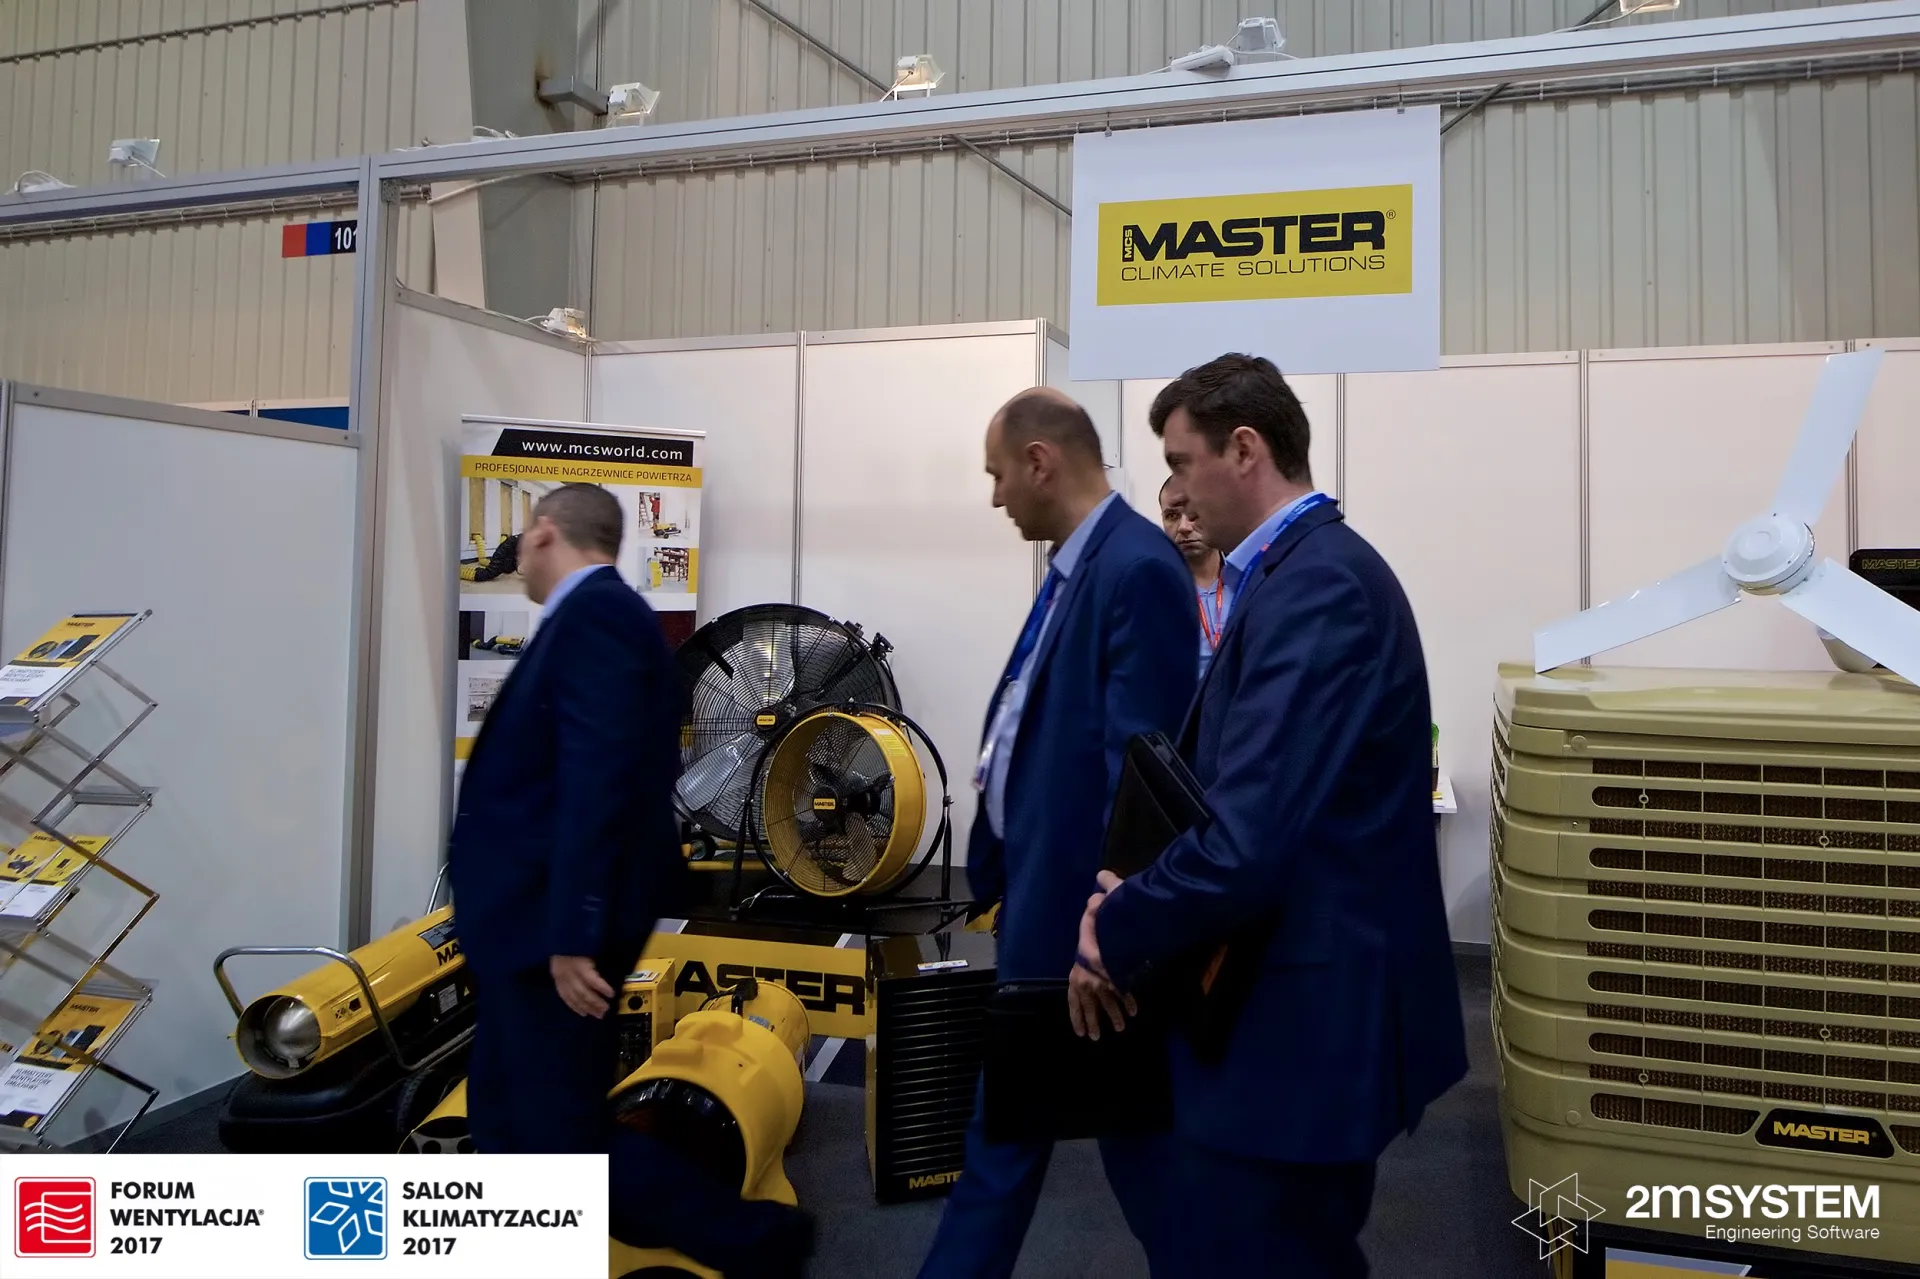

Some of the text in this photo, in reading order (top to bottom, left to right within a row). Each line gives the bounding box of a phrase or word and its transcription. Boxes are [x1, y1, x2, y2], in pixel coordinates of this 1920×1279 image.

[1121, 254, 1385, 281] CLIMATE SOLUTIONS
[521, 440, 684, 461] www.mcsworld.com
[475, 461, 692, 483] PROFESJONALNE NAGRZEWNICE POWIETRZA
[675, 960, 866, 1016] ASTER
[909, 1171, 963, 1189] MASTE
